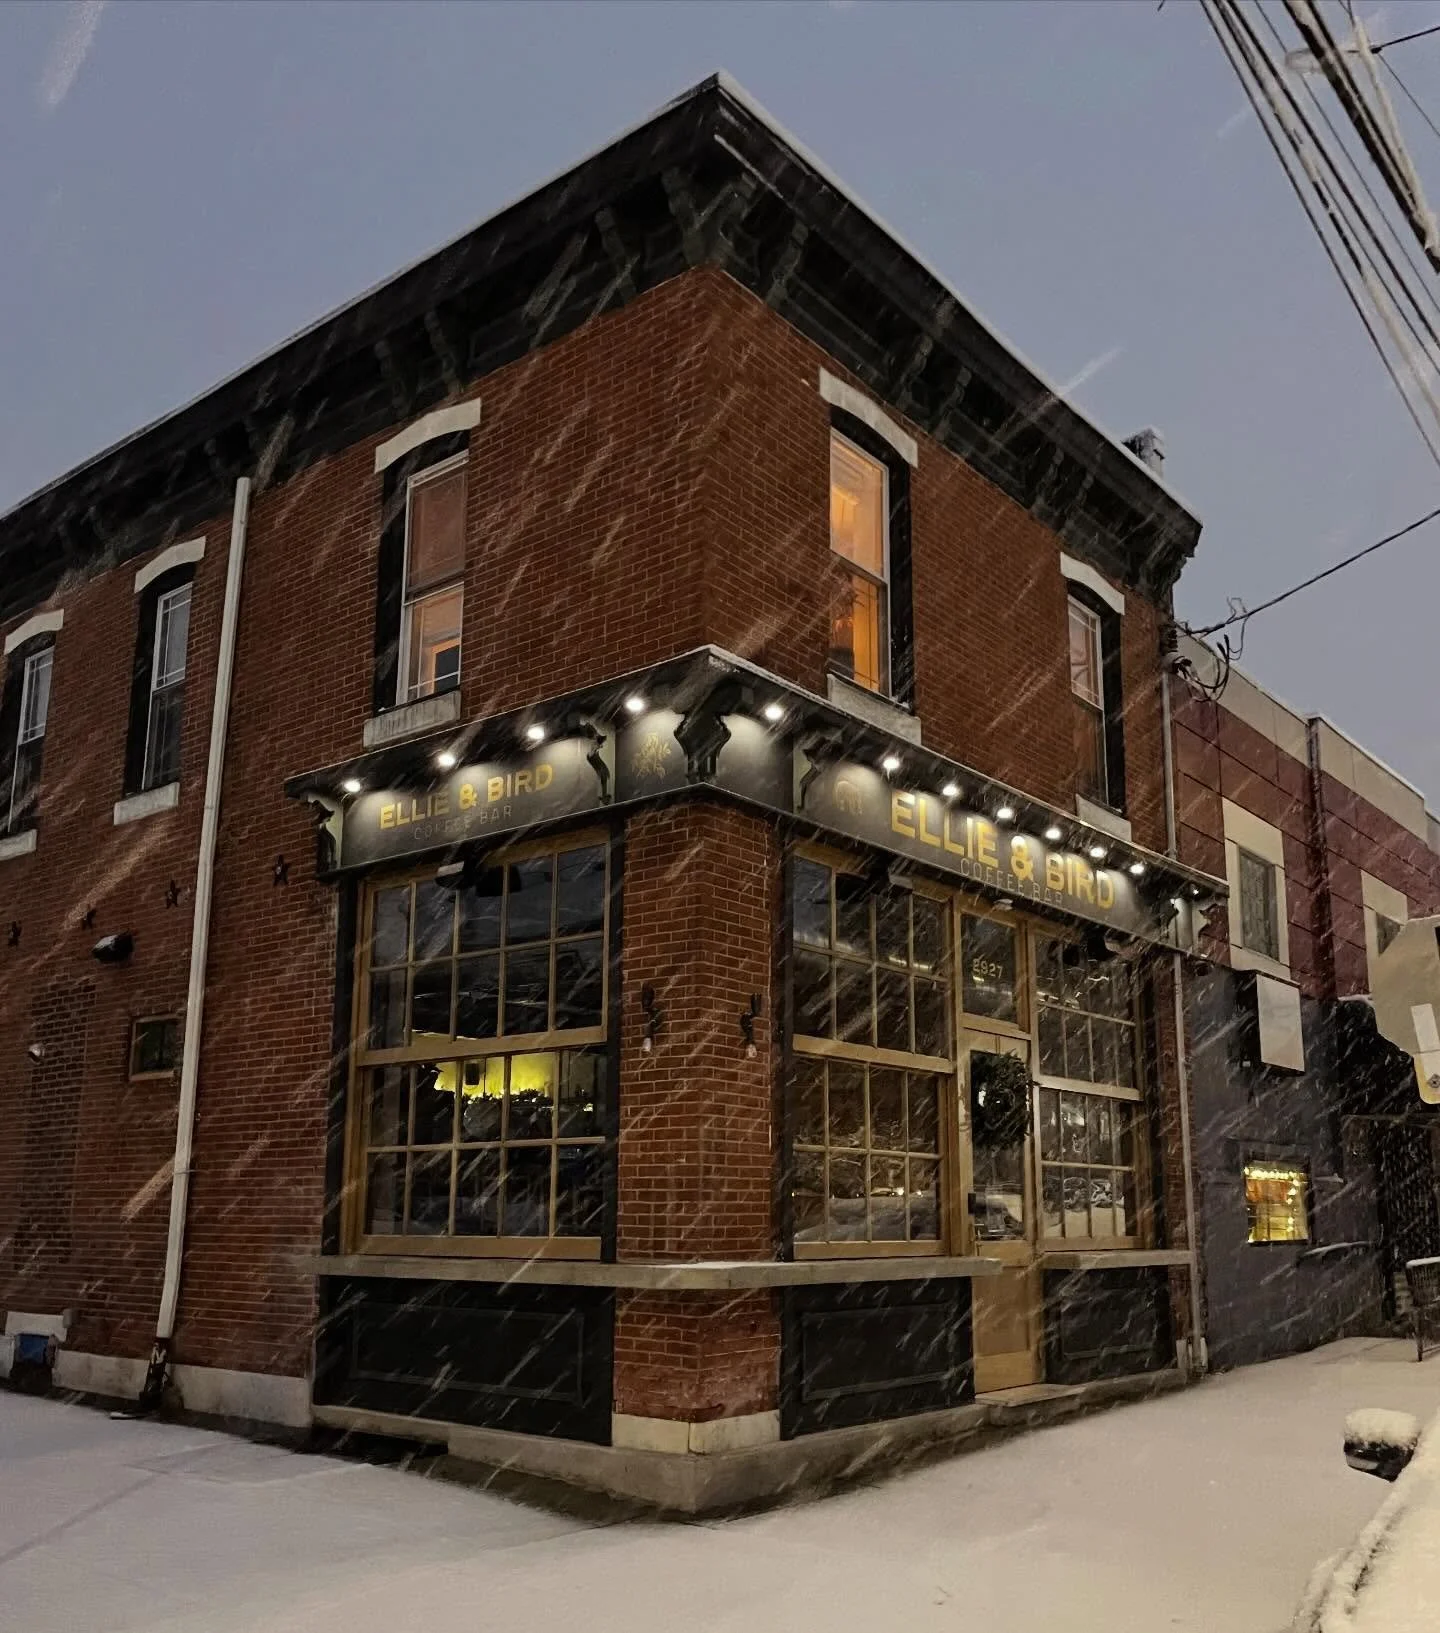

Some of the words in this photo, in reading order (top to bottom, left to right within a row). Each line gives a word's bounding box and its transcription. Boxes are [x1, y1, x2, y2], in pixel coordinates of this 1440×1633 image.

[379, 791, 450, 830] ELLIE
[459, 783, 478, 812] &
[487, 763, 553, 804] BIRD
[480, 805, 512, 825] BAR
[891, 789, 999, 868] ELLIE
[1010, 835, 1035, 881] &
[1045, 851, 1115, 910] BIRD
[960, 857, 1025, 896] COFFEE
[1031, 881, 1063, 907] BAR
